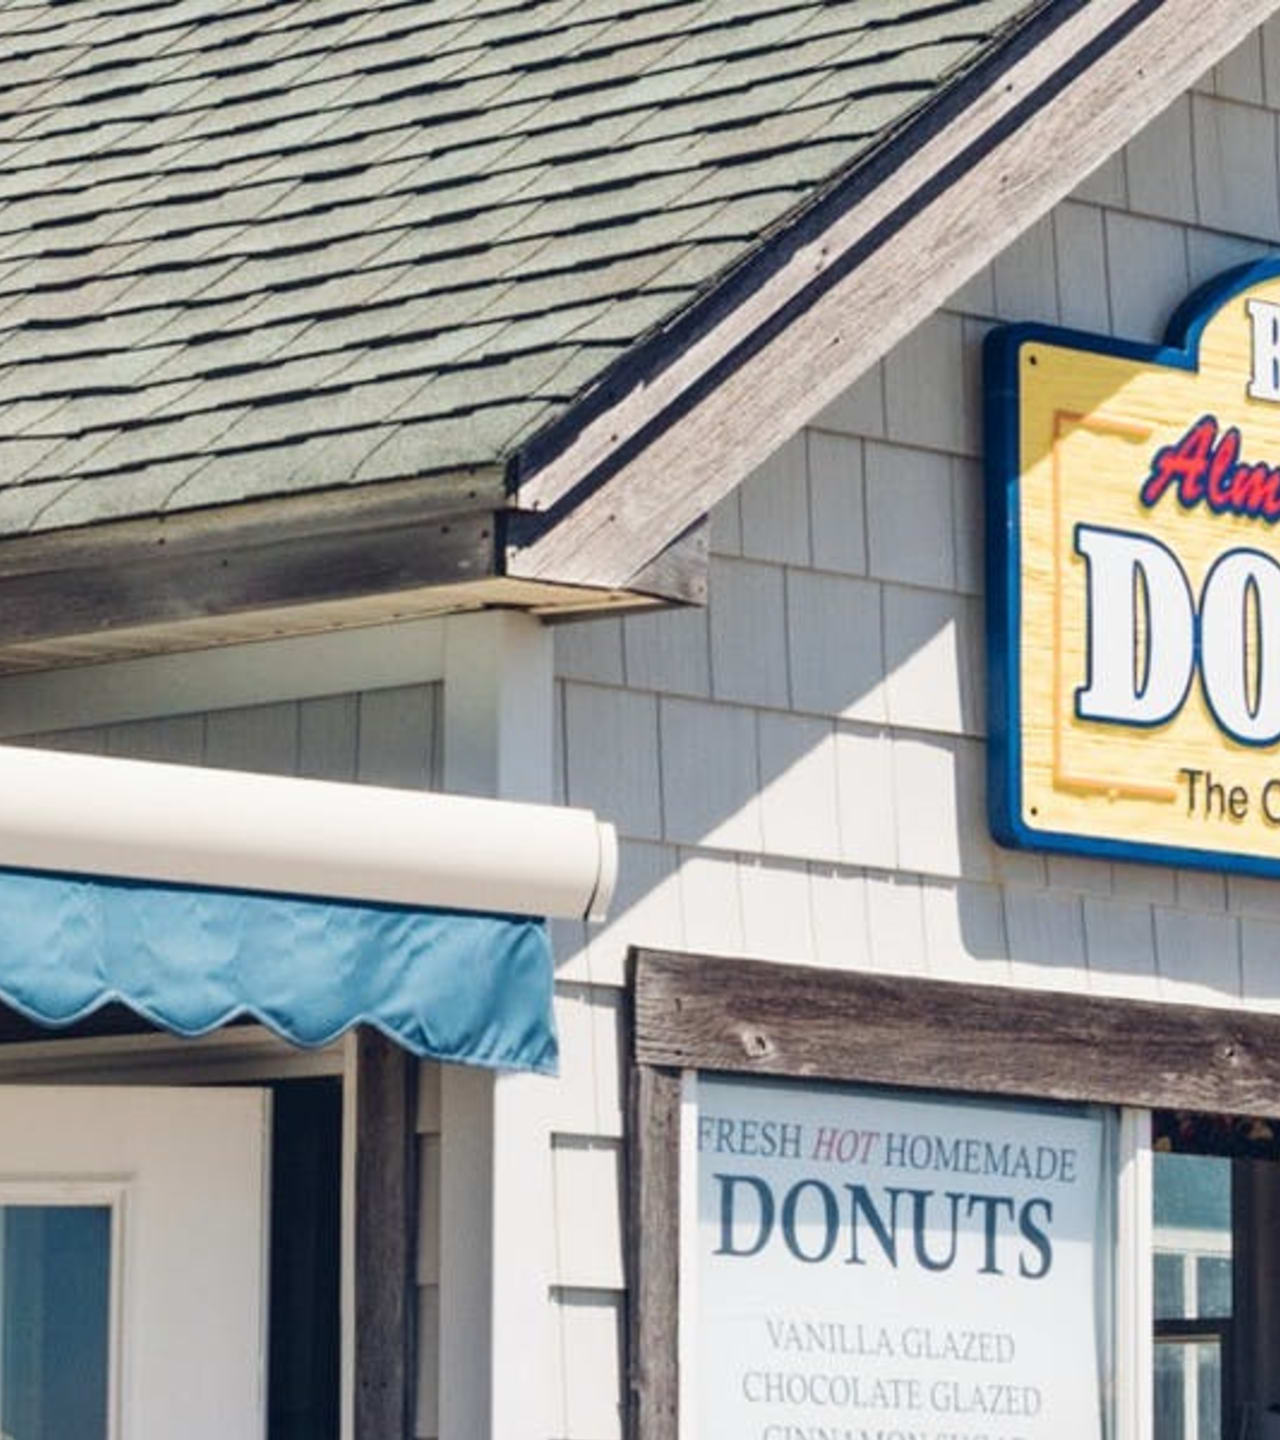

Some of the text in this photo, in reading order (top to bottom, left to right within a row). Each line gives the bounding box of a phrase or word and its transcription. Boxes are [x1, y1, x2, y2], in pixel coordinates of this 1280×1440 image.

[1181, 769, 1247, 819] The
[697, 1115, 1078, 1183] FRESH HOT HOMEMADE
[712, 1172, 1054, 1280] DONUTS
[765, 1318, 1016, 1364] VANILLA GLAZED
[742, 1370, 1042, 1418] CHOCOLATE GLAZED
